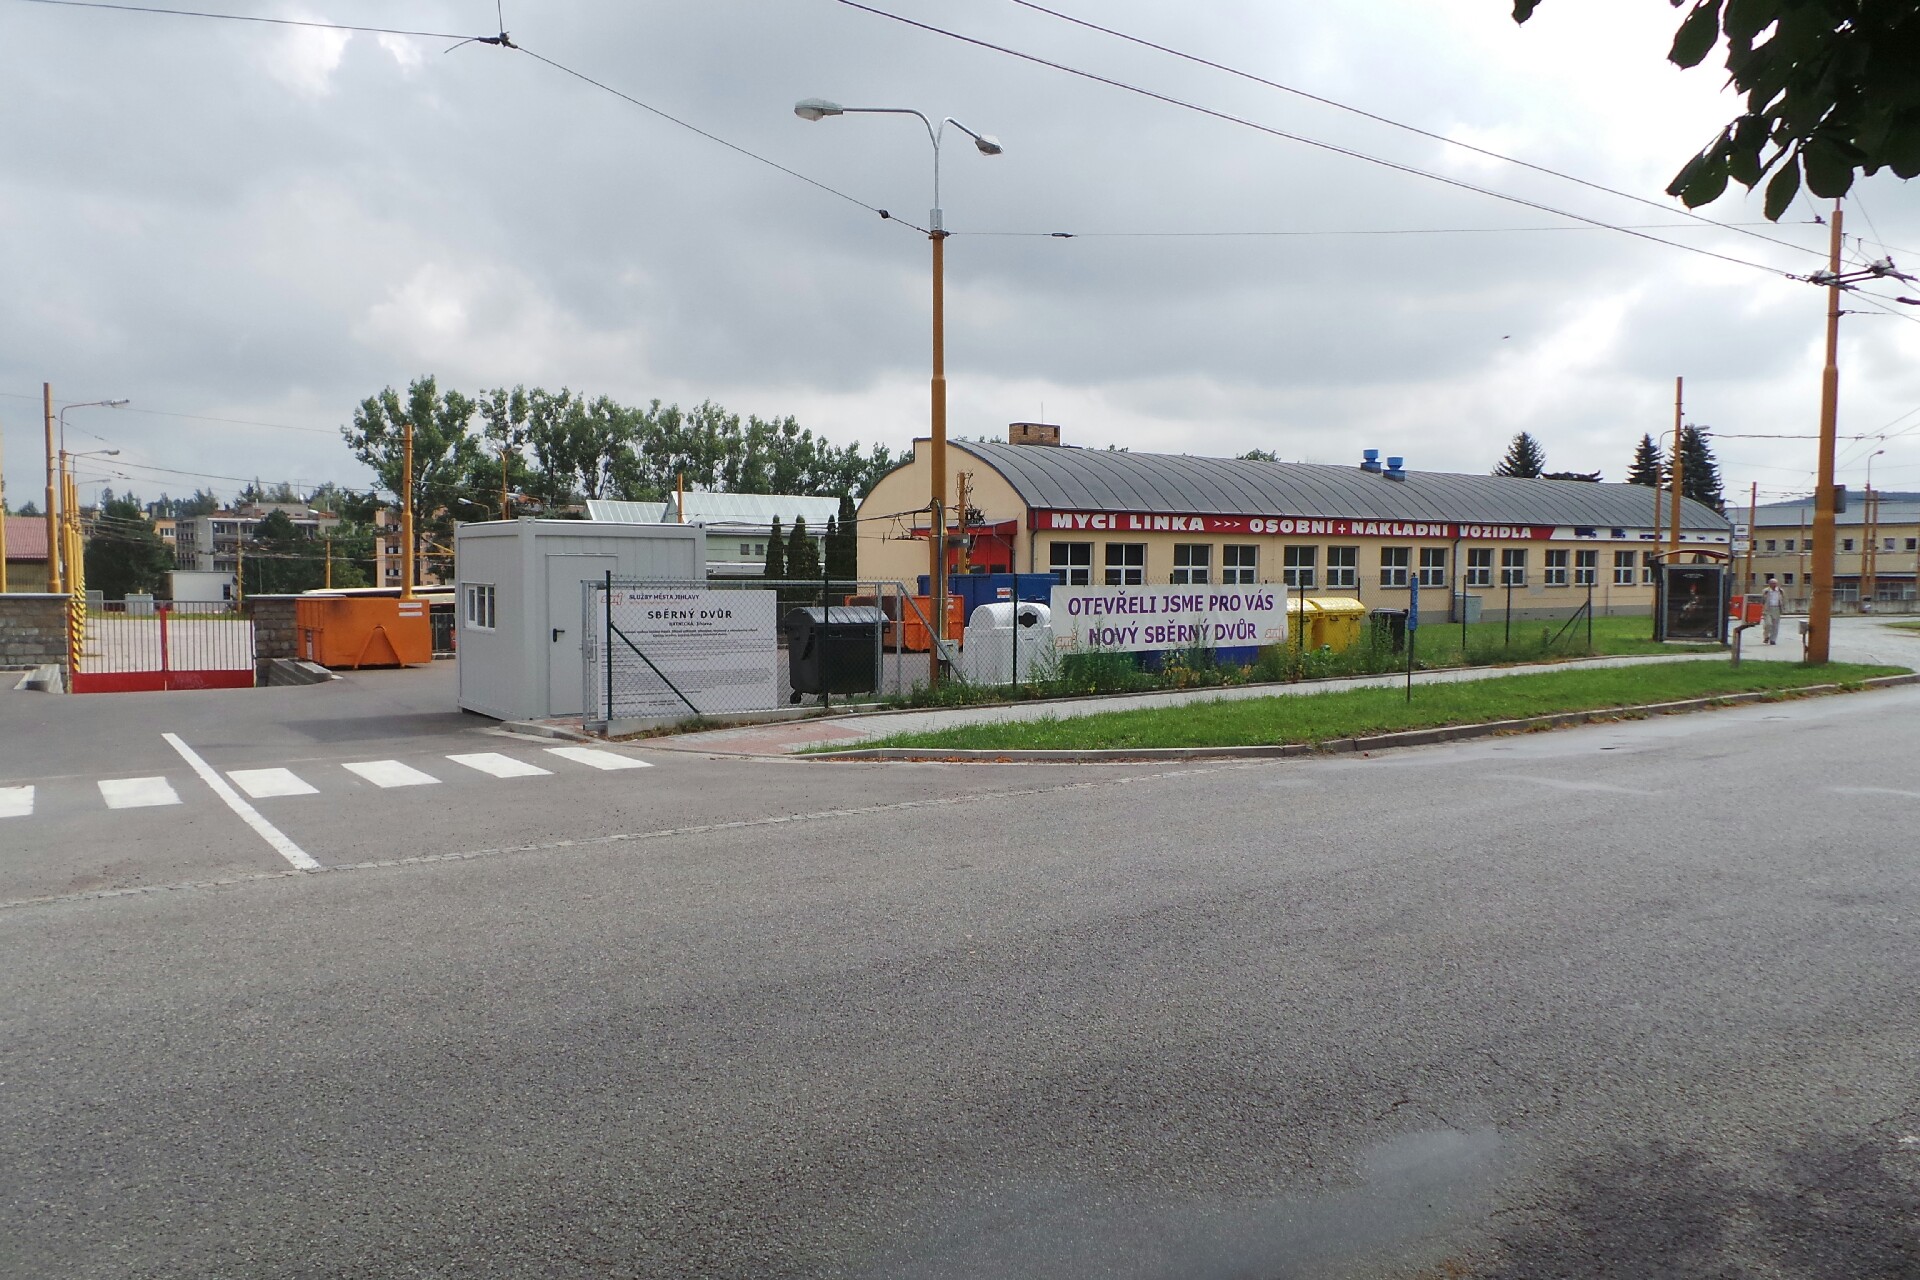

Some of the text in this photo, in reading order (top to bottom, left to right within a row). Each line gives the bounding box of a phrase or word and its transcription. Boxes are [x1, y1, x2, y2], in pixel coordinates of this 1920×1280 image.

[1051, 513, 1118, 529] MYCÍ
[1129, 514, 1205, 531] LINKA
[1250, 518, 1335, 534] OSOBNÍ
[1351, 521, 1449, 537] NÁKLADNÍ
[1460, 525, 1532, 539] VOZIDLA
[647, 607, 733, 619] SBĚRNÝ DVŮR
[1068, 588, 1274, 616] OTEVŘELI JSME PRO VÁS
[1088, 618, 1257, 646] NOVÝ SBĚRNÝ DVŮR
